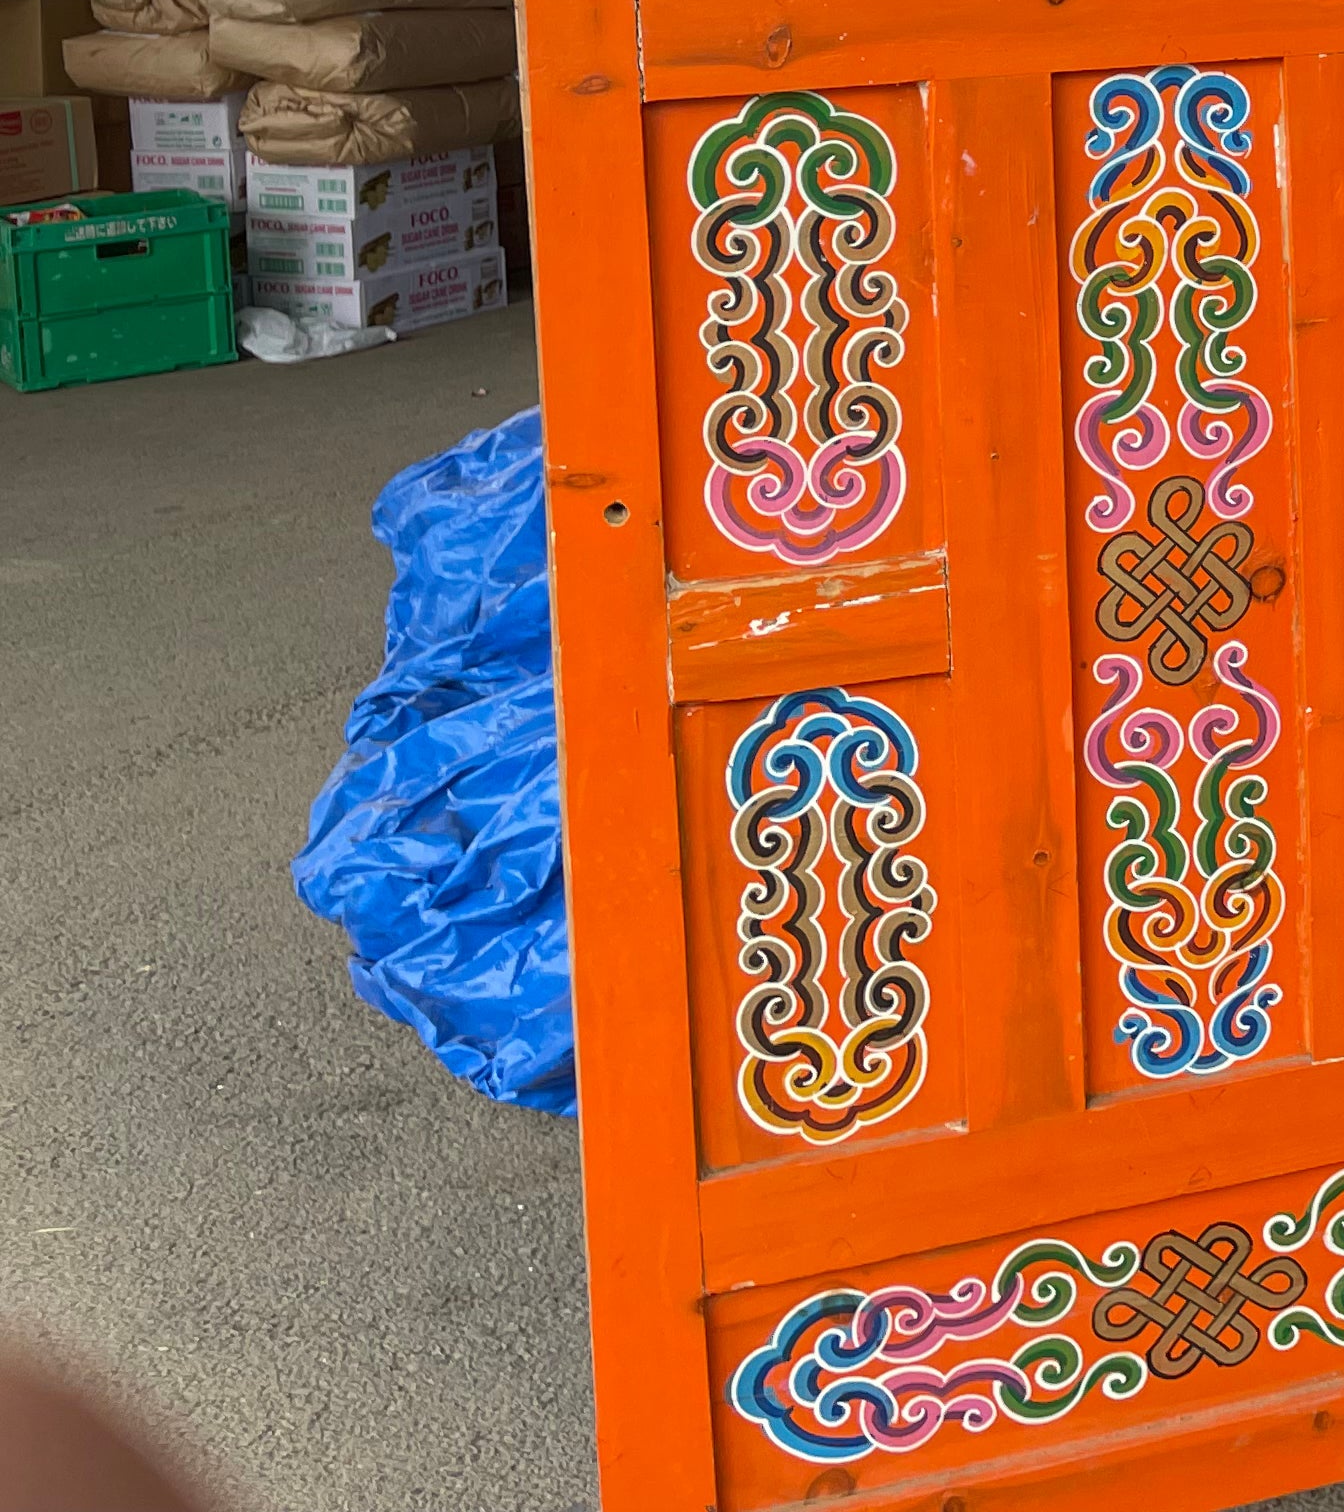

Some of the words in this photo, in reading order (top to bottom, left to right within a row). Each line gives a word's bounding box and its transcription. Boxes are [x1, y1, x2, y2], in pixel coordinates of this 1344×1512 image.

[410, 206, 450, 228] FOCO
[256, 281, 290, 295] FOCO
[419, 266, 459, 288] FOCO
